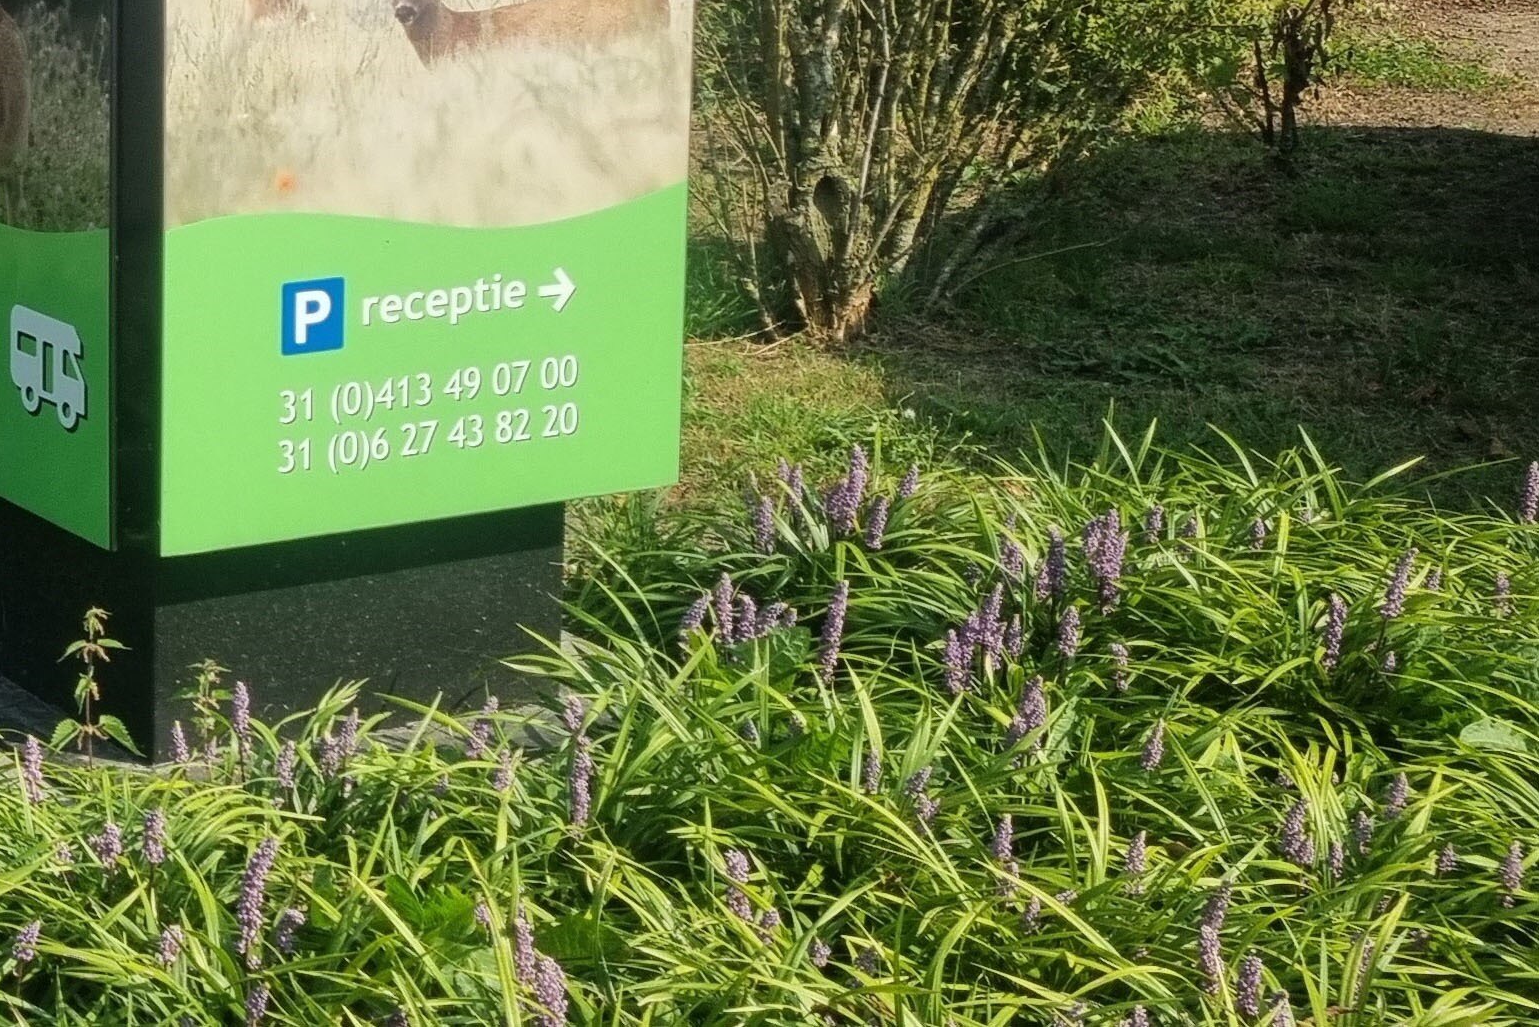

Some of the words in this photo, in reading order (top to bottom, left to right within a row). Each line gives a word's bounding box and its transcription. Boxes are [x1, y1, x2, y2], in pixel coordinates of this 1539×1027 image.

[294, 289, 332, 345] P
[361, 273, 528, 325] receptie
[278, 388, 313, 424] 31
[331, 373, 433, 424] (0)413
[442, 367, 481, 402] 49
[492, 360, 531, 397] 07
[540, 354, 579, 390] 00
[277, 439, 312, 473] 31
[327, 429, 390, 474] (0)6
[400, 421, 438, 457] 27
[447, 416, 484, 450] 43
[495, 409, 531, 444] 82
[541, 402, 580, 437] 20
